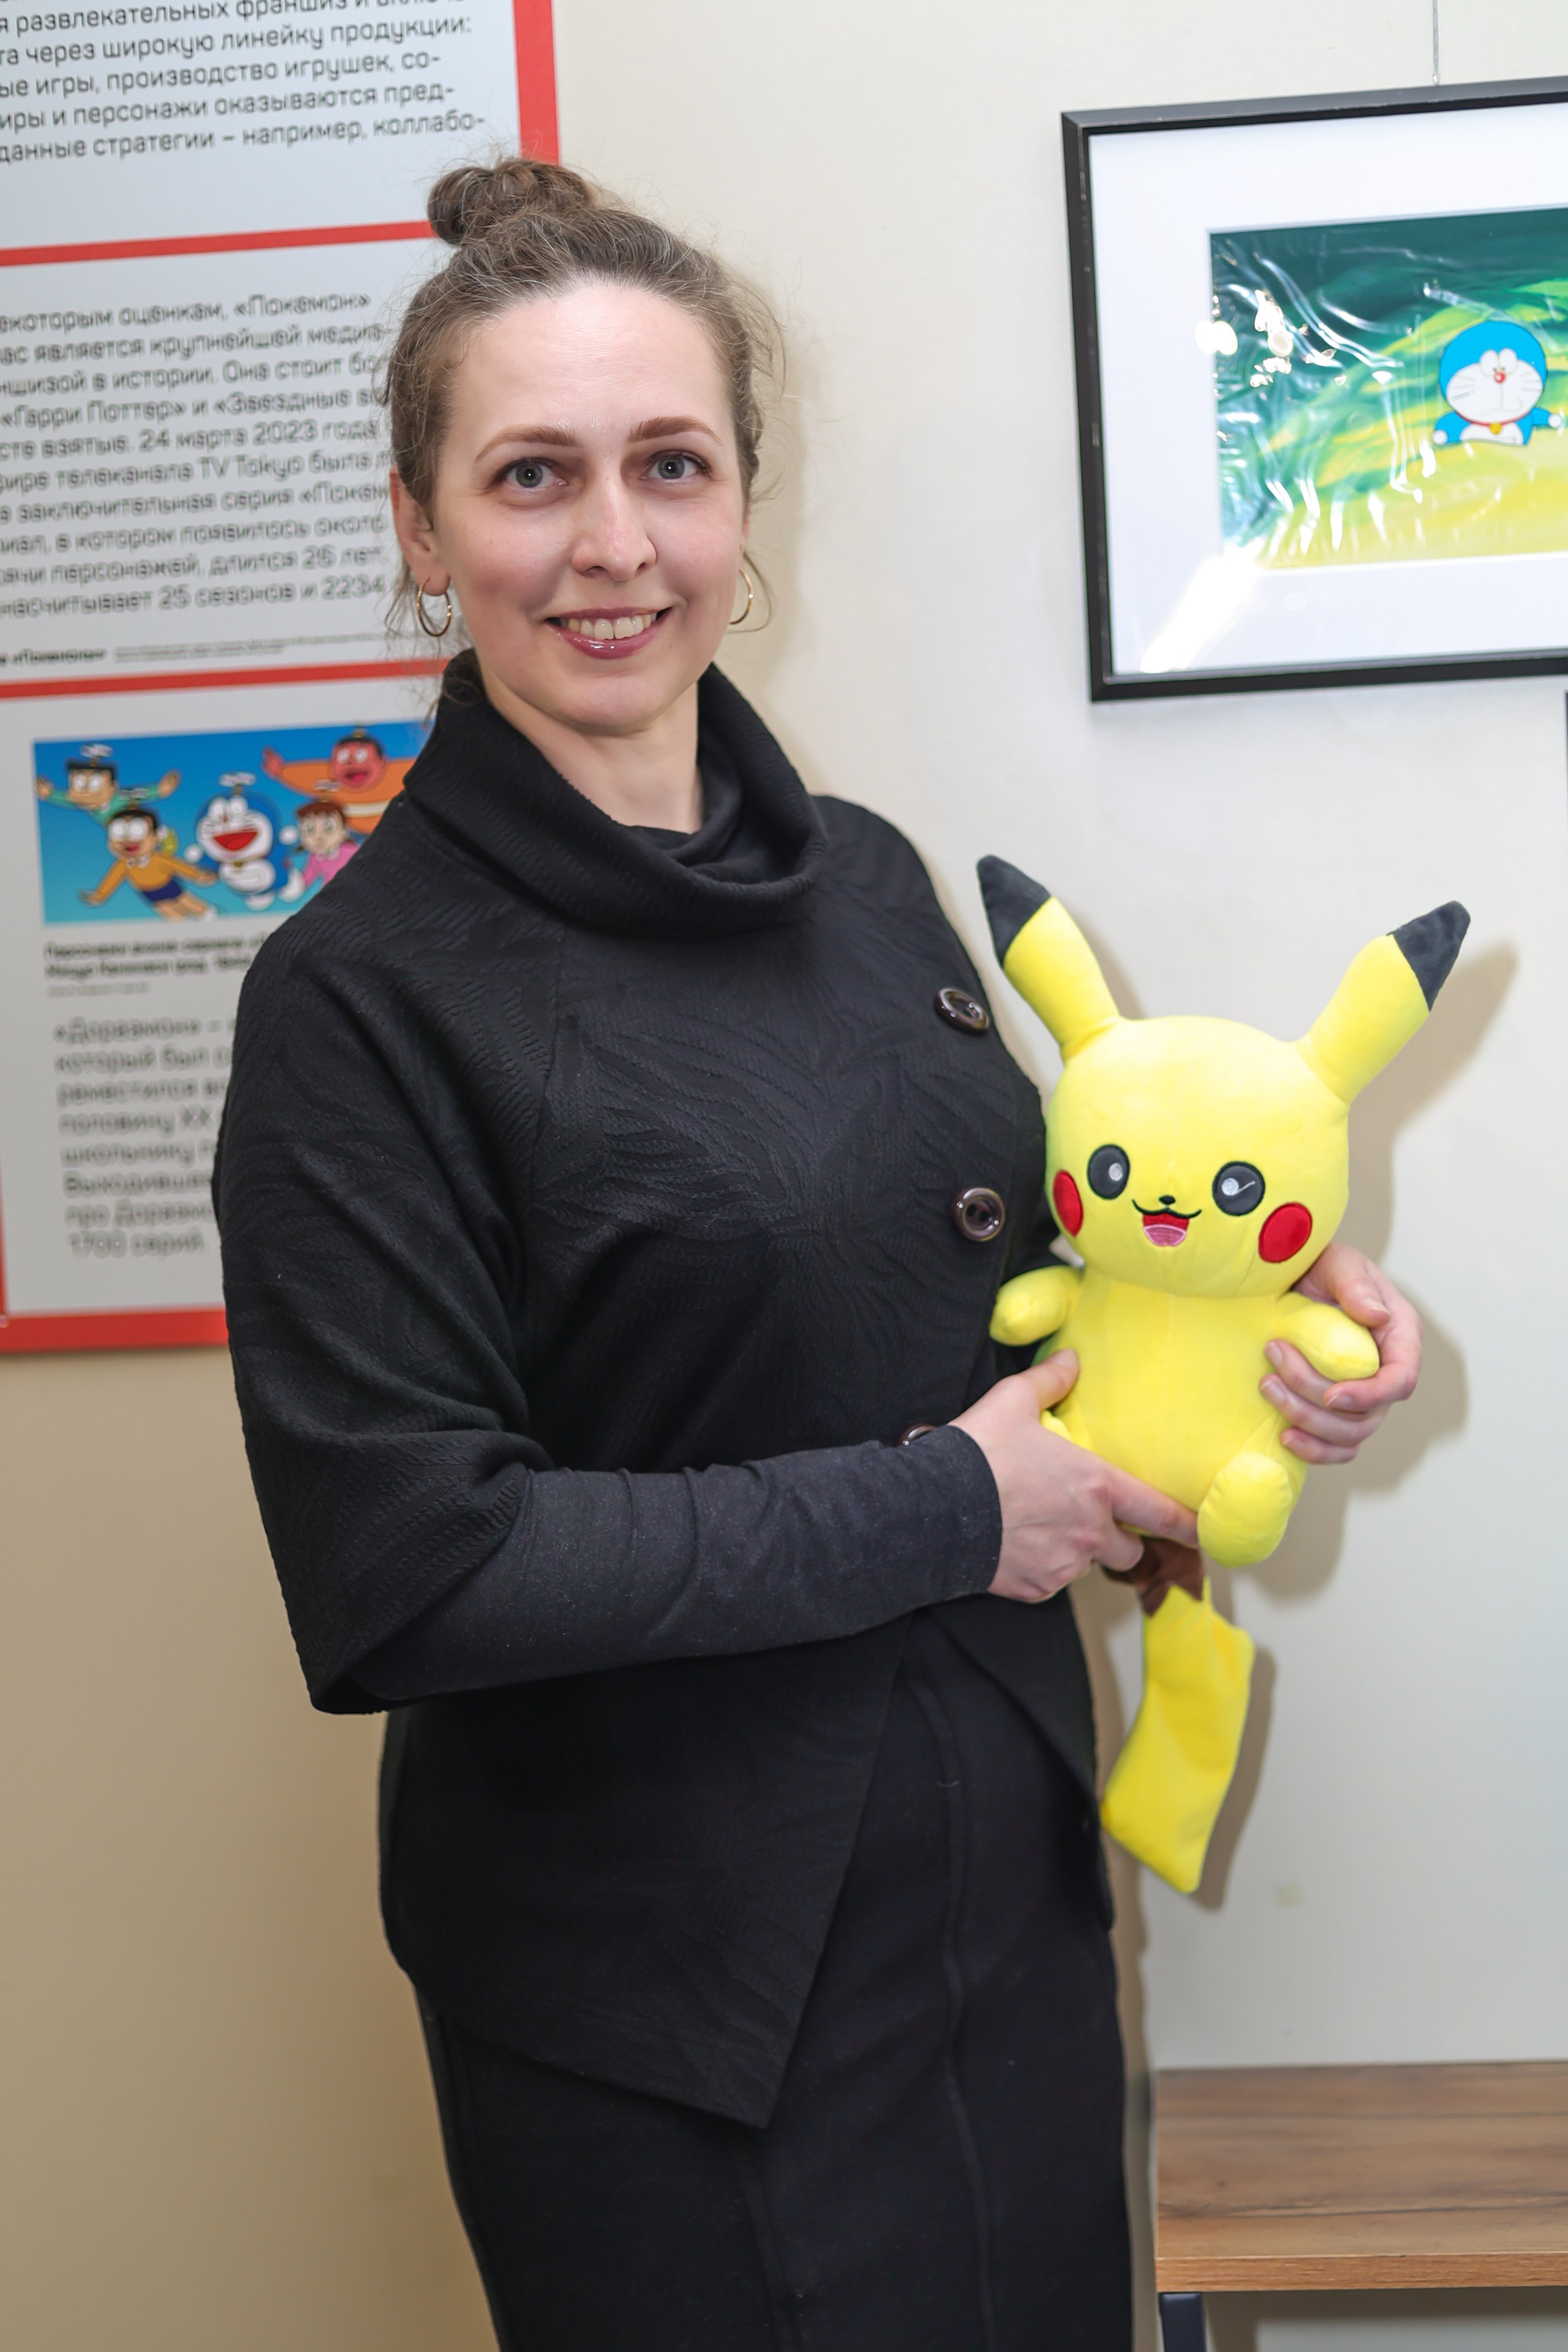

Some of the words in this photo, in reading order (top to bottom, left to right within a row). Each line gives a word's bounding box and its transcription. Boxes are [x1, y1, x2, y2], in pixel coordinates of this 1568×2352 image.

[17, 2, 230, 38] развлекательных
[236, 0, 345, 22] франшиз
[26, 43, 95, 67] через
[103, 34, 214, 62] широкую
[221, 24, 323, 50] линейку
[331, 17, 471, 47] продукции:
[36, 76, 100, 99] игры,
[107, 62, 278, 95] производство
[285, 55, 395, 81] игрушек,
[401, 51, 440, 70] со-
[53, 110, 67, 126] и
[74, 100, 208, 129] персонажи
[214, 88, 377, 116] оказываются
[384, 83, 454, 108] пред-
[93, 132, 214, 159] стратегии
[243, 121, 367, 148] например,
[374, 110, 485, 135] коллабо-
[118, 303, 228, 327] оценкам,
[233, 293, 371, 317] «Покемон»
[34, 338, 145, 363] является
[149, 324, 302, 361] крупнейшей
[92, 373, 108, 392] в
[222, 360, 271, 383] Она
[274, 358, 344, 380] стоит
[1, 404, 83, 432] «Гарри
[87, 399, 187, 424] Поттер»
[192, 400, 209, 417] и
[213, 389, 352, 415] «Звездные
[138, 428, 171, 453] 24
[176, 428, 248, 453] марта
[252, 418, 318, 446] 2023
[55, 462, 194, 489] телеканала
[197, 456, 231, 480] TV
[233, 454, 305, 483] Tokyo
[308, 449, 373, 483] была
[17, 492, 217, 524] заключительная
[221, 488, 295, 513] серия
[55, 533, 71, 553] в
[75, 527, 176, 552] котором
[180, 519, 311, 545] появилось
[314, 509, 388, 538] около
[302, 544, 336, 570] 26
[159, 584, 191, 610] 25
[195, 582, 296, 608] сезонов
[300, 583, 318, 600] и
[321, 573, 386, 600] 2234
